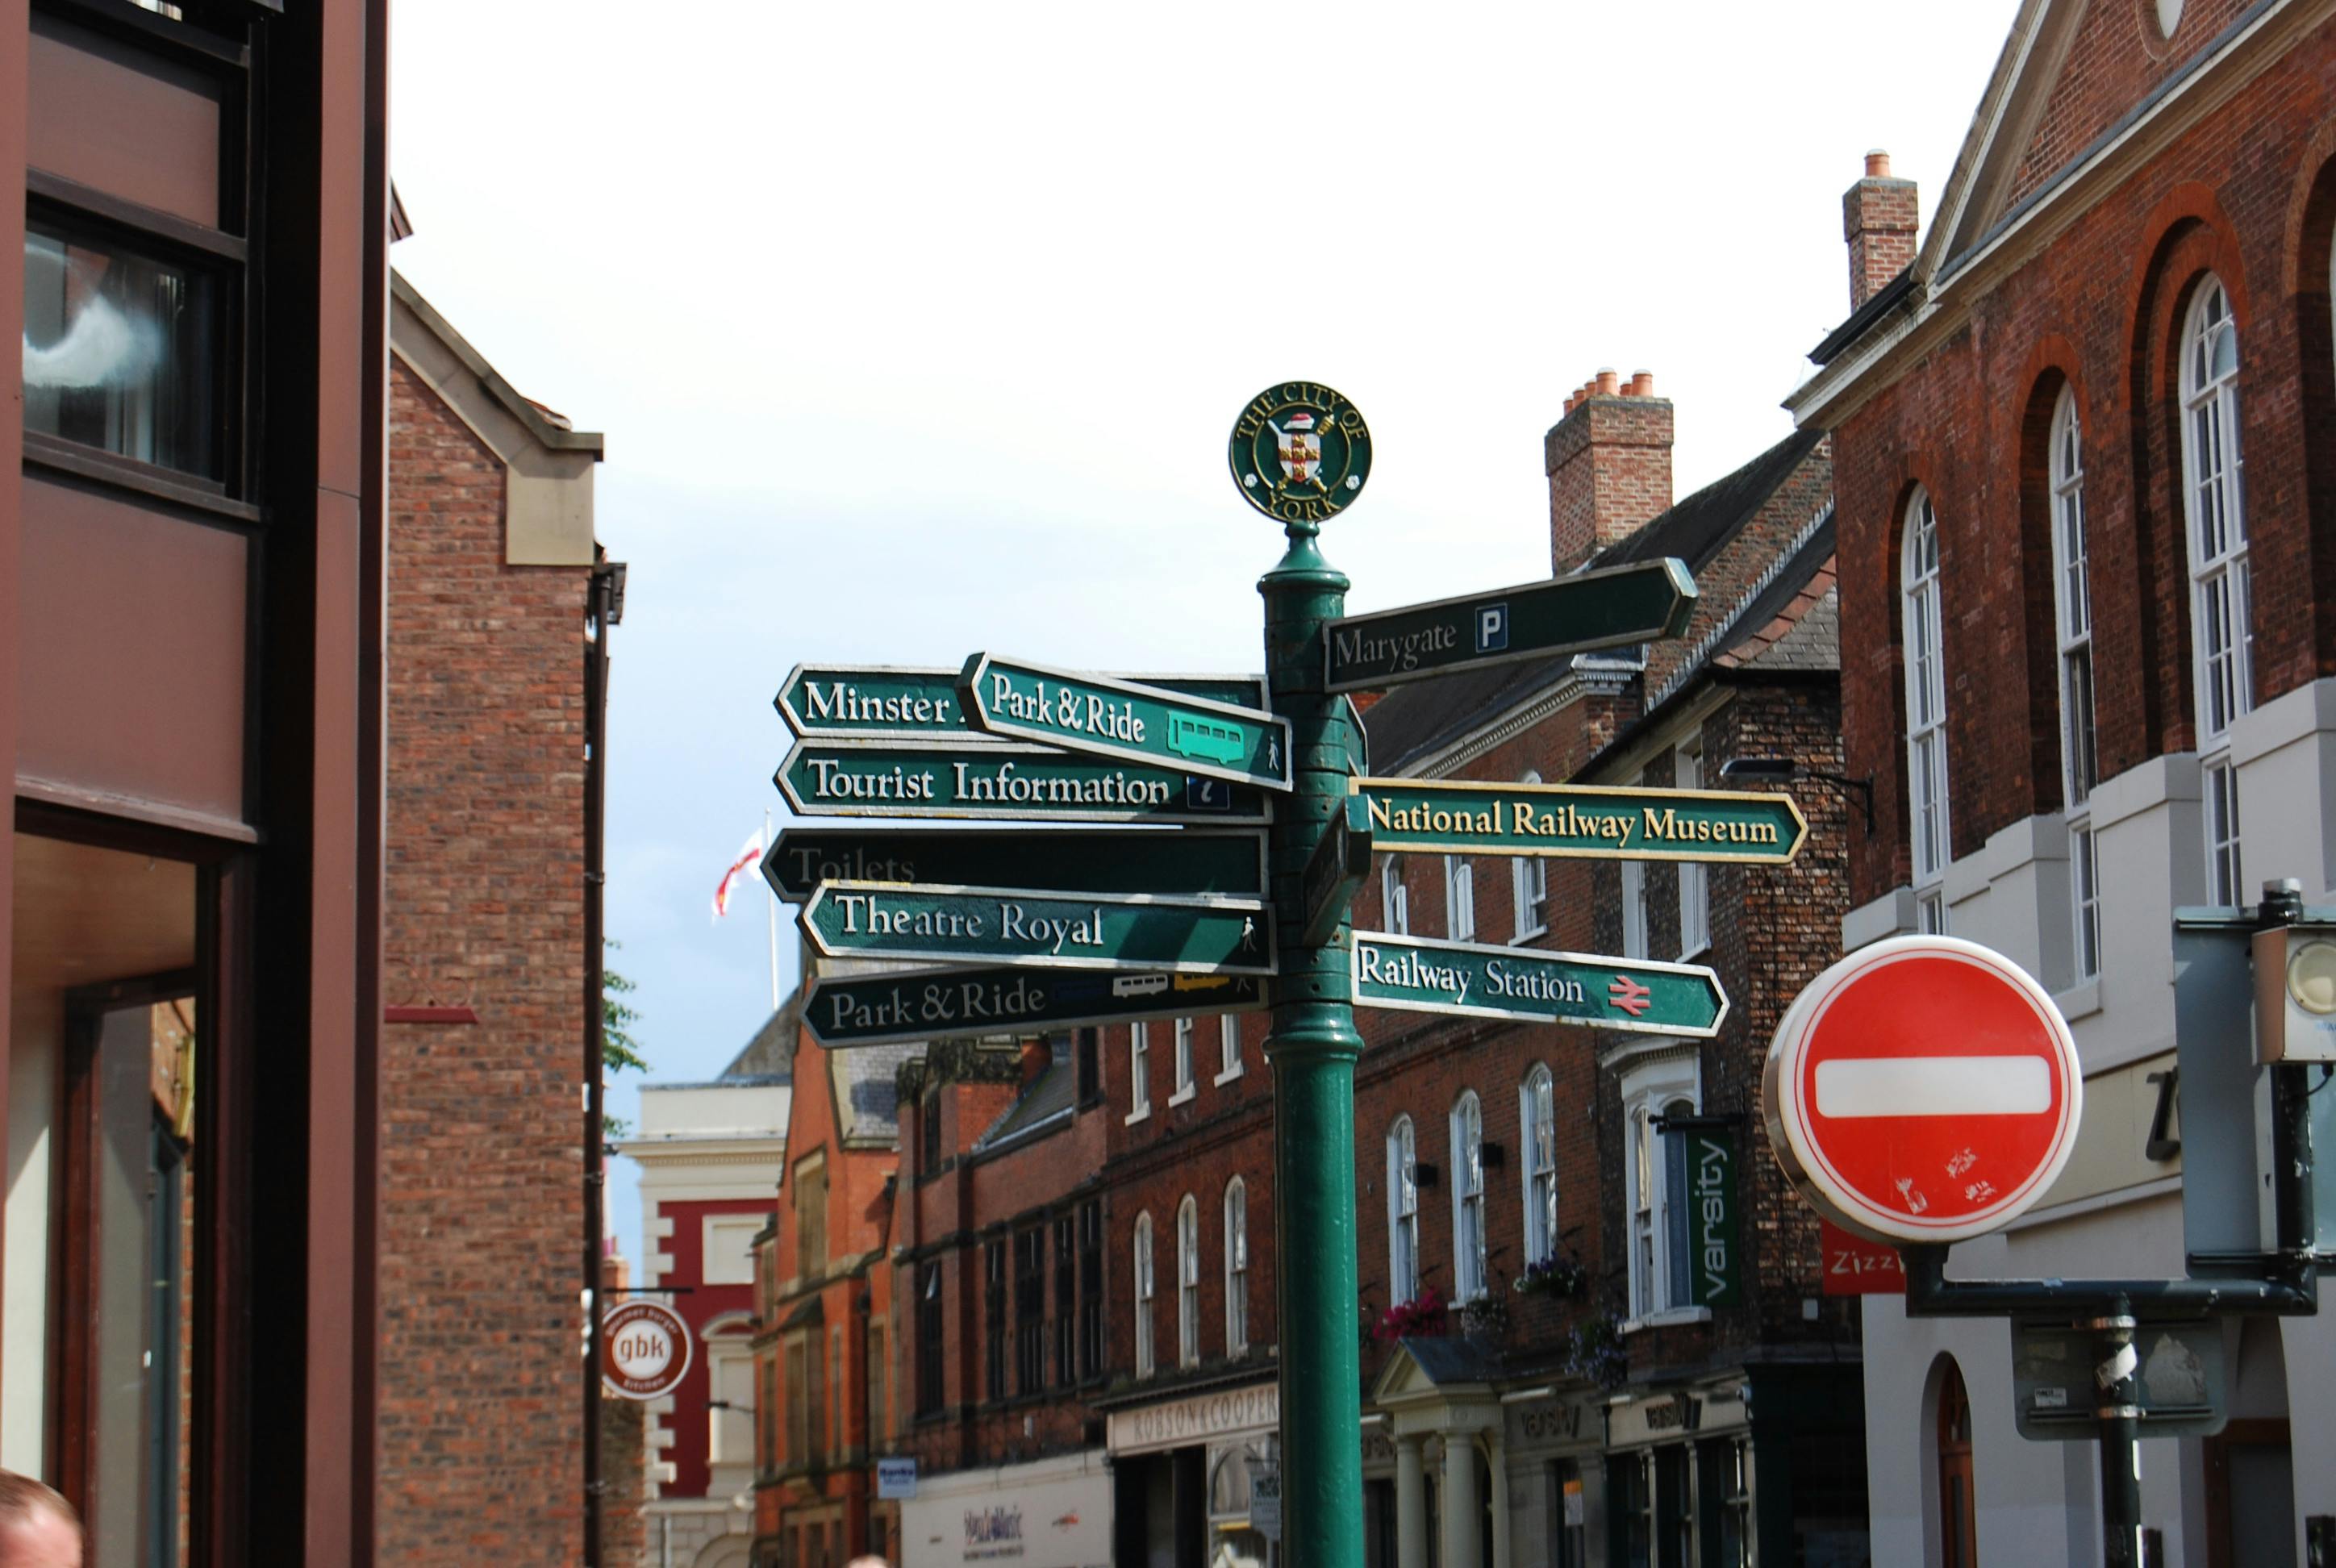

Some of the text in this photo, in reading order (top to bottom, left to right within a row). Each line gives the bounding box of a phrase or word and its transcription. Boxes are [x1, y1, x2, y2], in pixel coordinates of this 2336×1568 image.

[1237, 383, 1368, 440] THE CITY OF
[1266, 490, 1342, 520] YORK
[1335, 624, 1457, 673] Marygate
[804, 681, 950, 723] Minster
[991, 673, 1054, 725] Park
[1085, 694, 1145, 743] Ride
[807, 758, 935, 799] Tourist
[952, 761, 1172, 805] Information
[1370, 798, 1779, 848] National Railway Museum
[789, 847, 916, 884] Toilets
[834, 894, 1104, 955] Theatre Royal
[1358, 946, 1585, 1004] Railway Station
[829, 976, 1047, 1030] Park & Ride
[1695, 1137, 1728, 1299] varsity
[620, 1333, 664, 1363] gbk
[1133, 1402, 1195, 1443] ROBSON
[1211, 1386, 1278, 1431] COOPER
